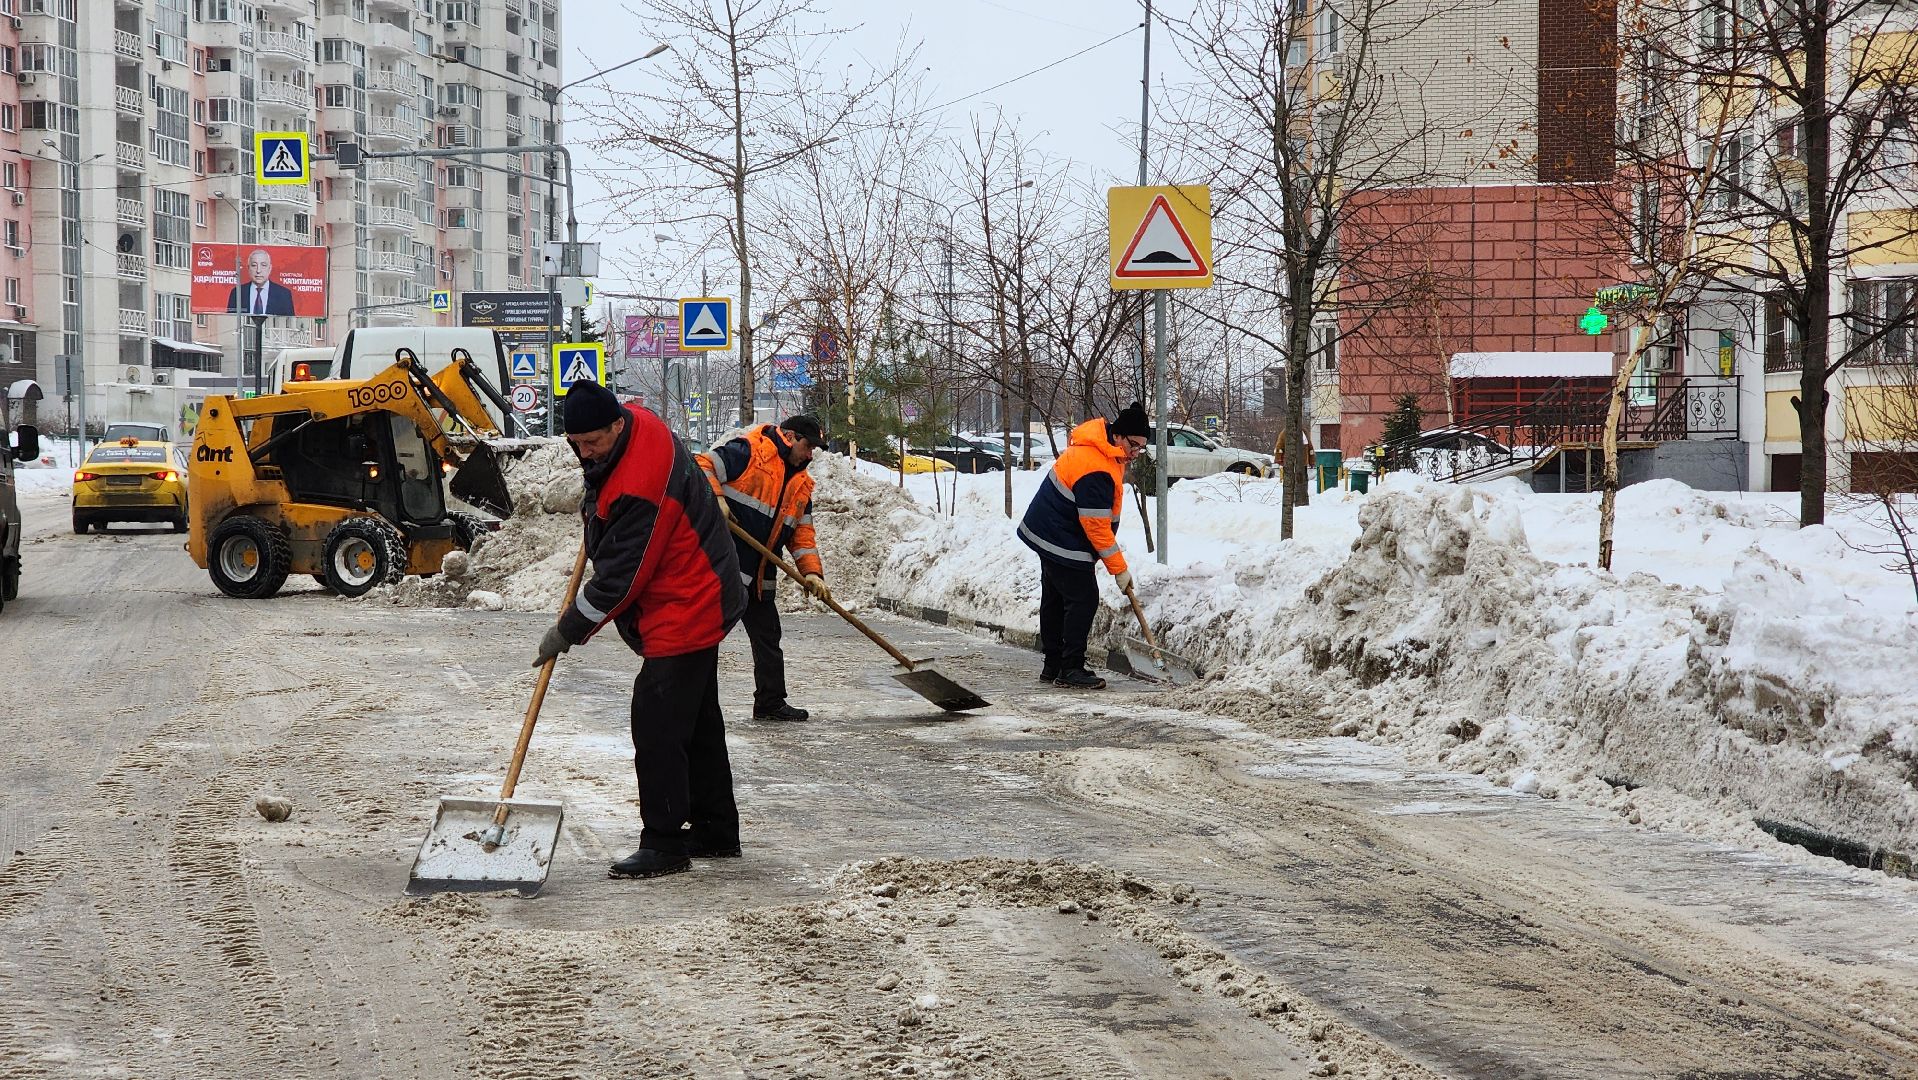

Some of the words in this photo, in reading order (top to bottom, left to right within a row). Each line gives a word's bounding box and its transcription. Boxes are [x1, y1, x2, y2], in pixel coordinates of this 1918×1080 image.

[283, 278, 323, 286] КАПИТАЛИЗМ
[348, 380, 407, 408] 1000
[517, 392, 531, 402] 20
[196, 444, 234, 462] ant
